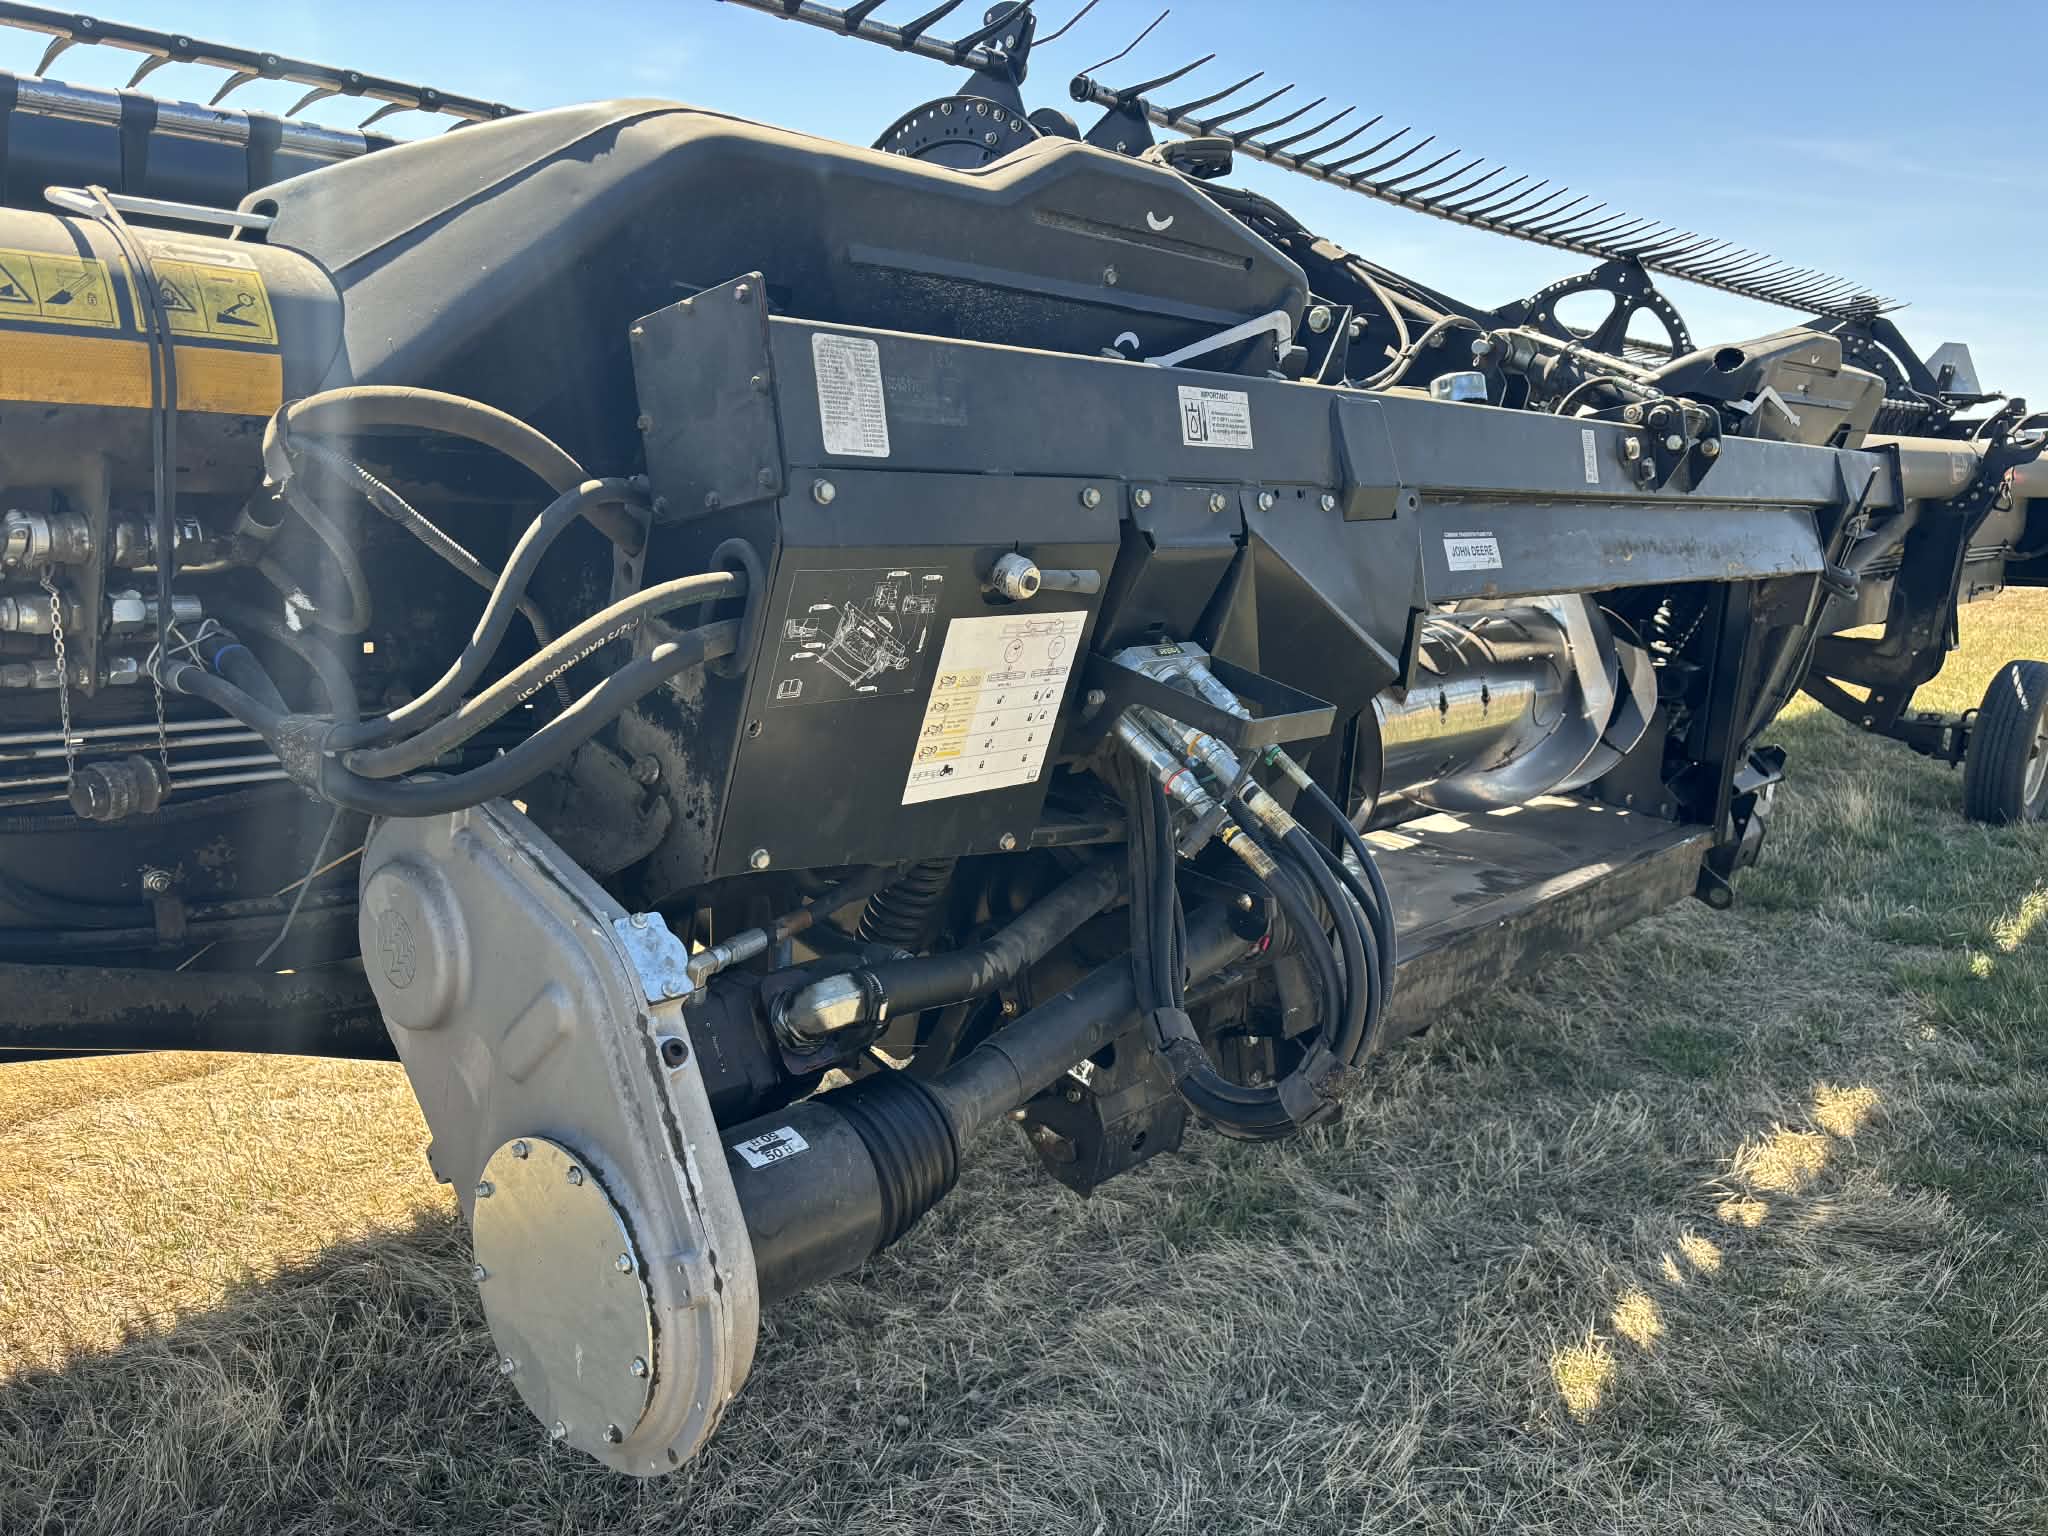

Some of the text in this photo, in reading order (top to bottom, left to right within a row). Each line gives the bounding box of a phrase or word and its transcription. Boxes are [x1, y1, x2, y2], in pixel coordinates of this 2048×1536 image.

[1200, 391, 1230, 401] IMPORTANT
[1451, 544, 1495, 557] JOHN DEERE
[760, 1132, 780, 1143] 50
[765, 1149, 784, 1161] 50
